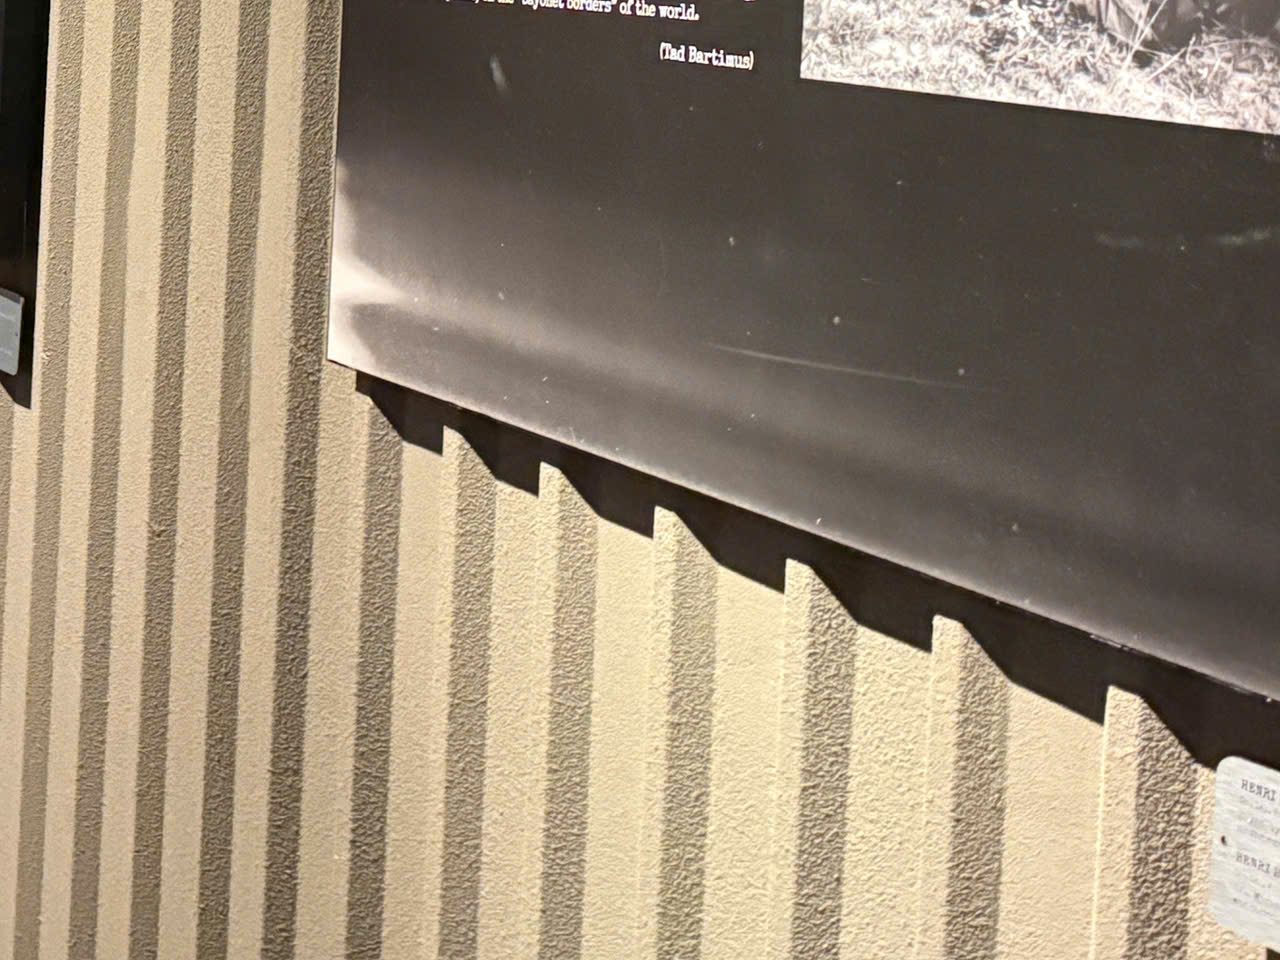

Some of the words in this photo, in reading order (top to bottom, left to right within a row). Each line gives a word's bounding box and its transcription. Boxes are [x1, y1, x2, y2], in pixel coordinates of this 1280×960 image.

[634, 0, 657, 17] the
[657, 2, 700, 21] world.
[659, 41, 686, 62] (Tad
[688, 45, 754, 71] Bartimus)
